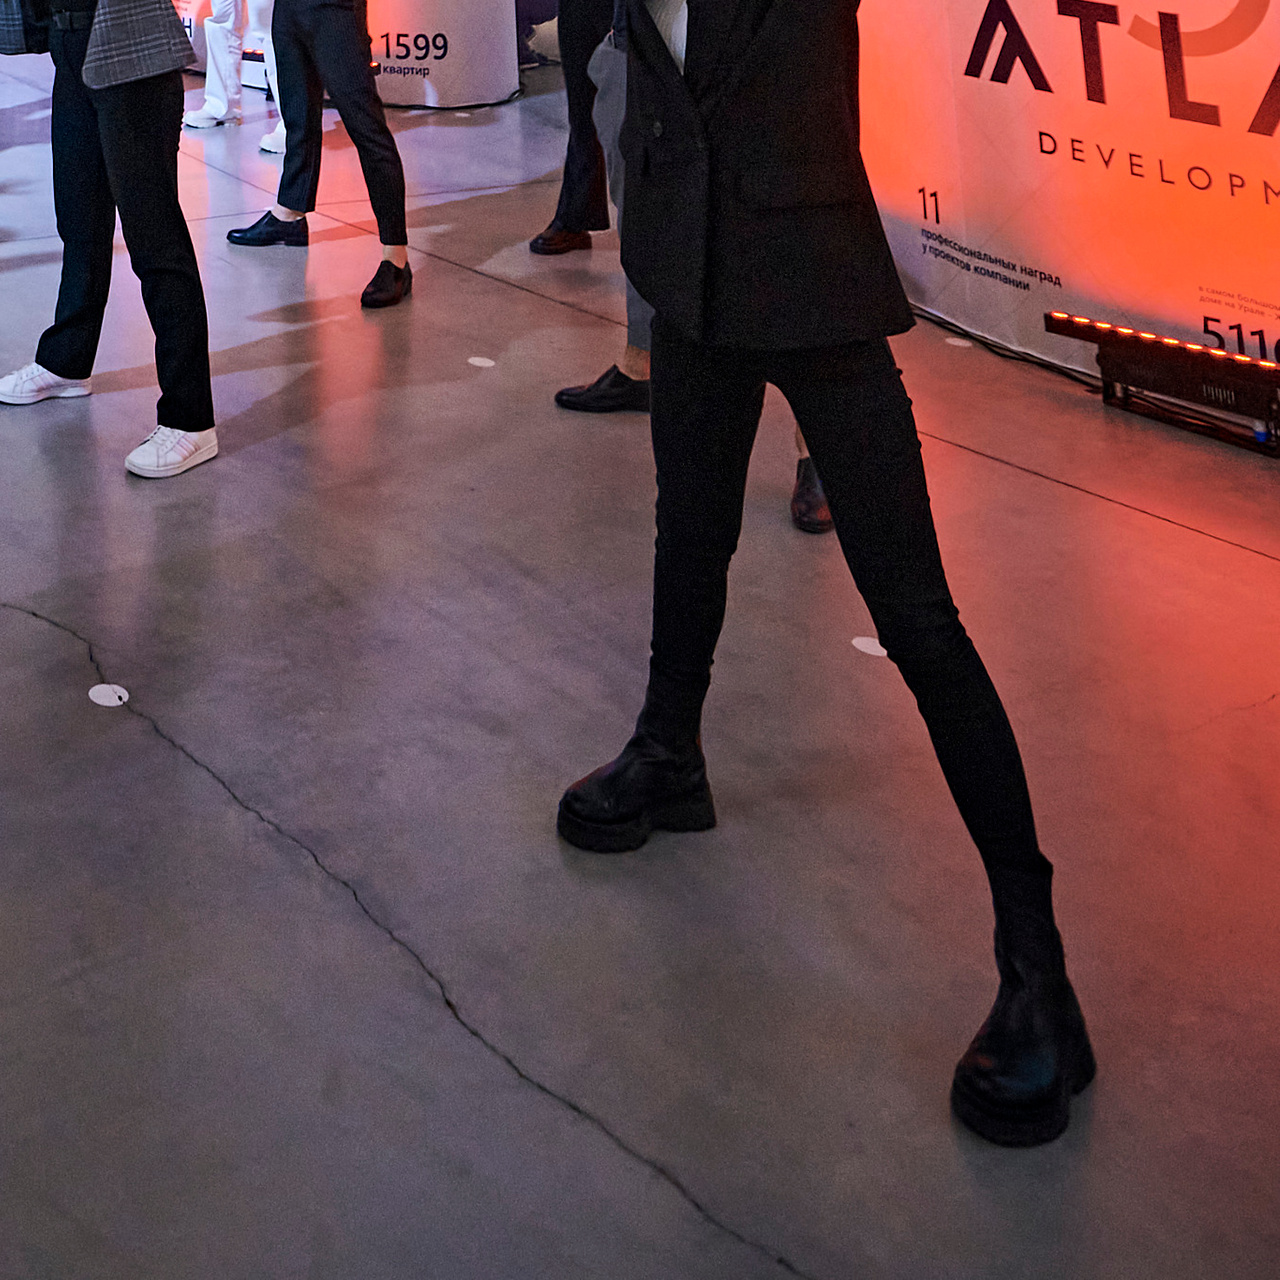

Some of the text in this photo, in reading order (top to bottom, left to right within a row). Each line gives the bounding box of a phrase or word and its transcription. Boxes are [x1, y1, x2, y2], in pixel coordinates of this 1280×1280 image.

[381, 32, 448, 60] 1599
[383, 65, 429, 77] квартир
[918, 187, 940, 224] 11
[921, 227, 1062, 288] профессиональных наград
[922, 243, 1030, 290] у проектов компании
